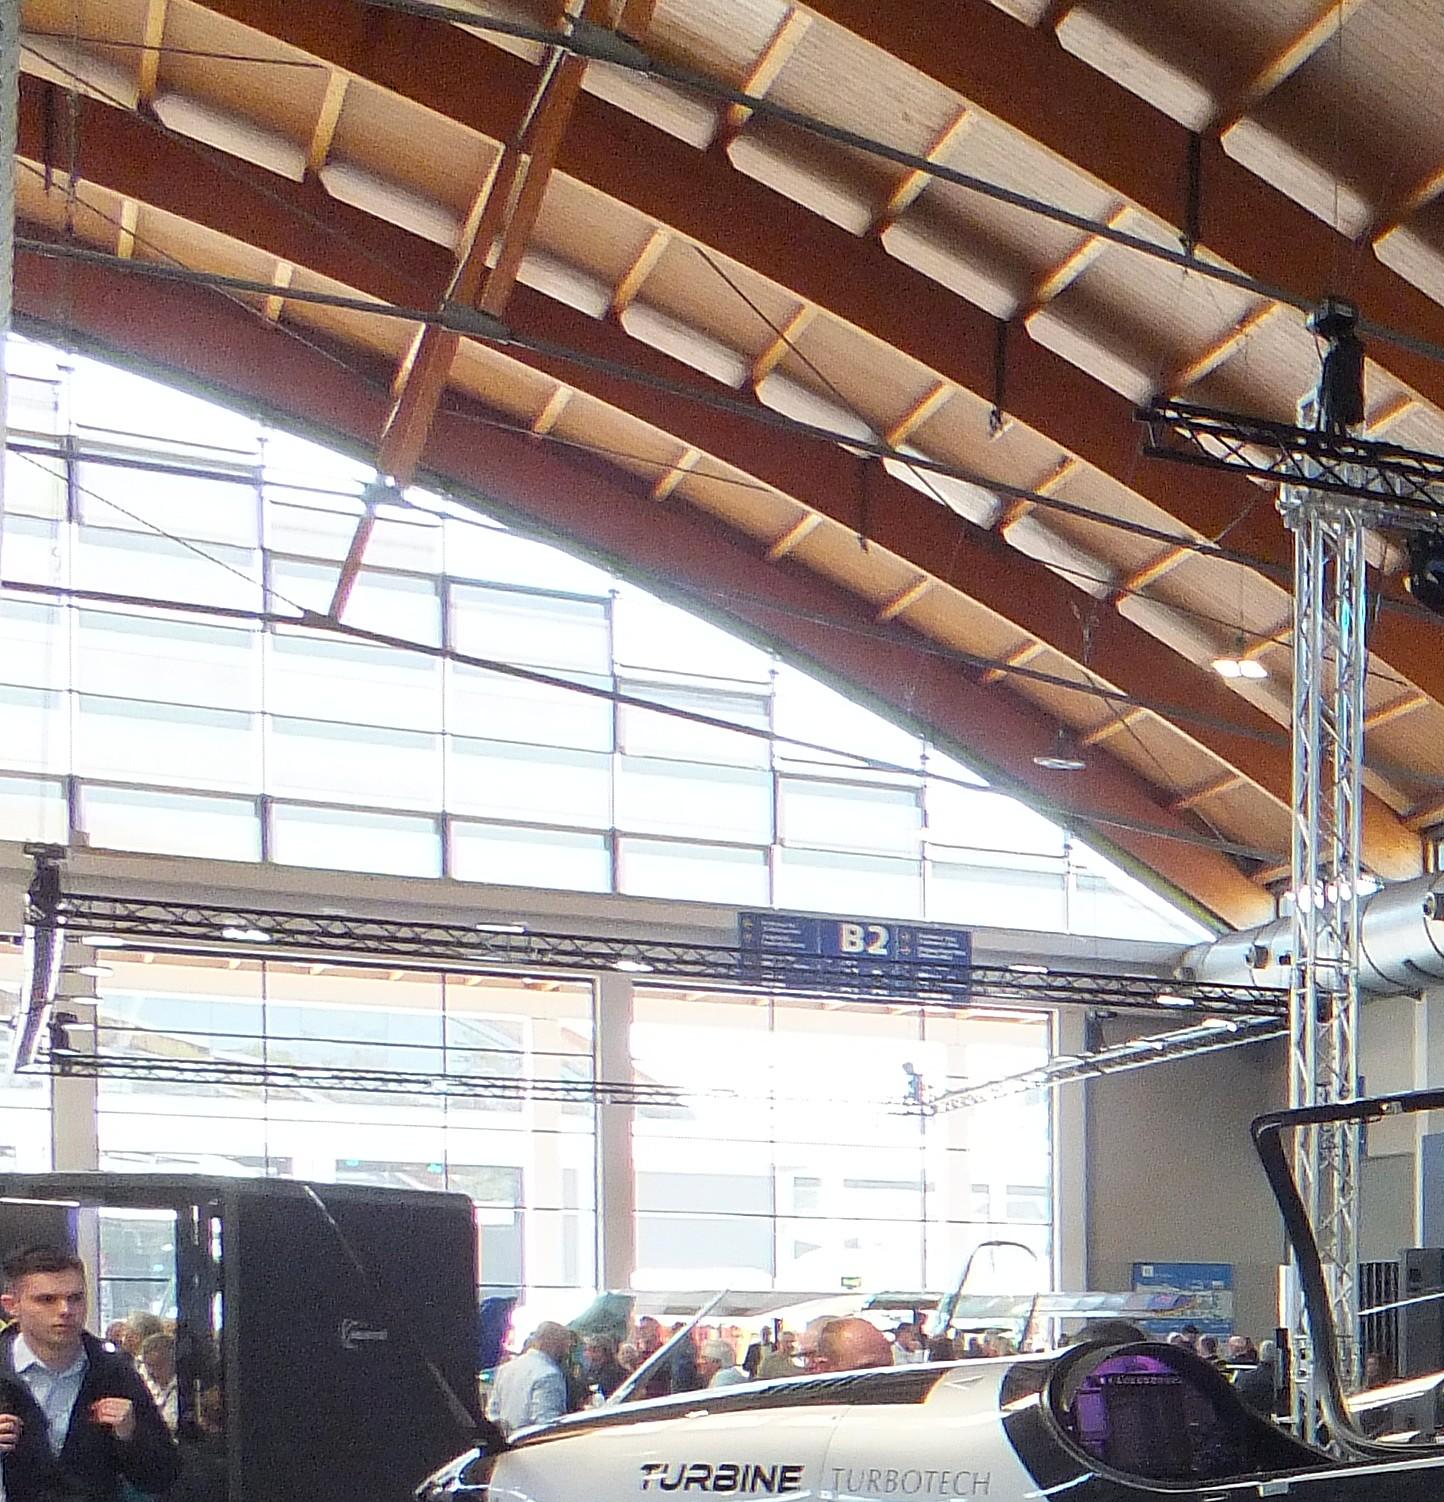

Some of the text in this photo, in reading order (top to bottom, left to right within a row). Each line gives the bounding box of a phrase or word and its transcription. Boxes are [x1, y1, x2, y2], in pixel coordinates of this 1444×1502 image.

[840, 923, 890, 956] B2
[638, 1462, 992, 1497] TURBINE TURBOTECH
